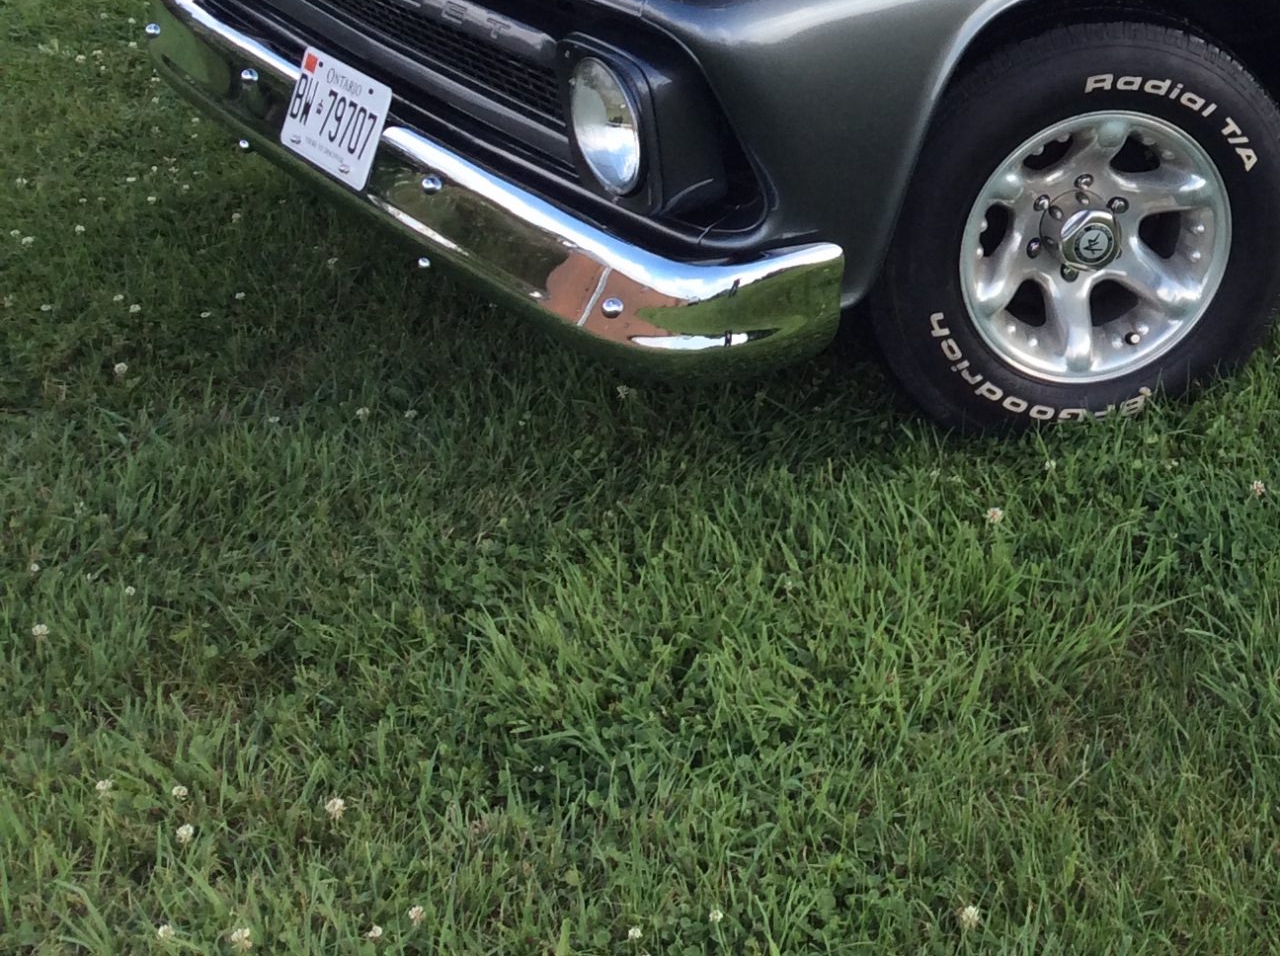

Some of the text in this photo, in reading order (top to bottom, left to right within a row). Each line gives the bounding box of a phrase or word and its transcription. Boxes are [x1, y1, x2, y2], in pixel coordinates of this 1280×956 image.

[289, 73, 319, 126] BW
[319, 89, 378, 161] 79707
[1084, 73, 1259, 172] Radial T/A
